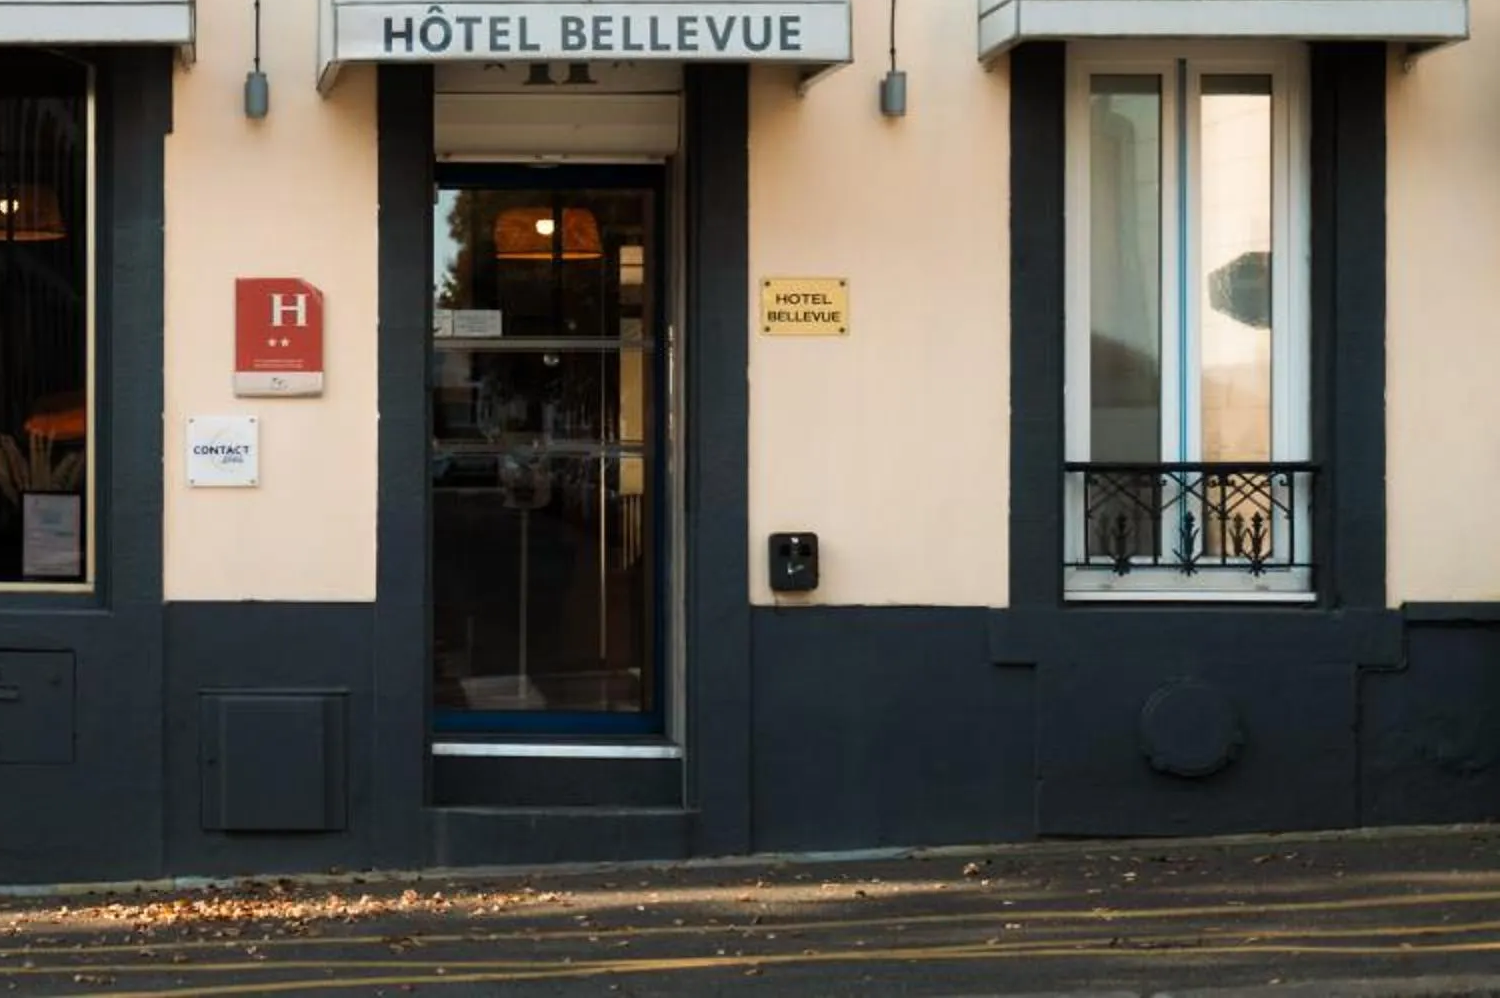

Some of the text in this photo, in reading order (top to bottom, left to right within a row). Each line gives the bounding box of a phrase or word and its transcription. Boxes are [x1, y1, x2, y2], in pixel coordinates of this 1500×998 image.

[384, 4, 802, 53] HÔTEL BELLEVUE
[775, 293, 833, 305] HOTEL
[269, 292, 308, 327] H
[767, 310, 841, 323] BELLEVUE
[192, 444, 249, 455] CONTACT
